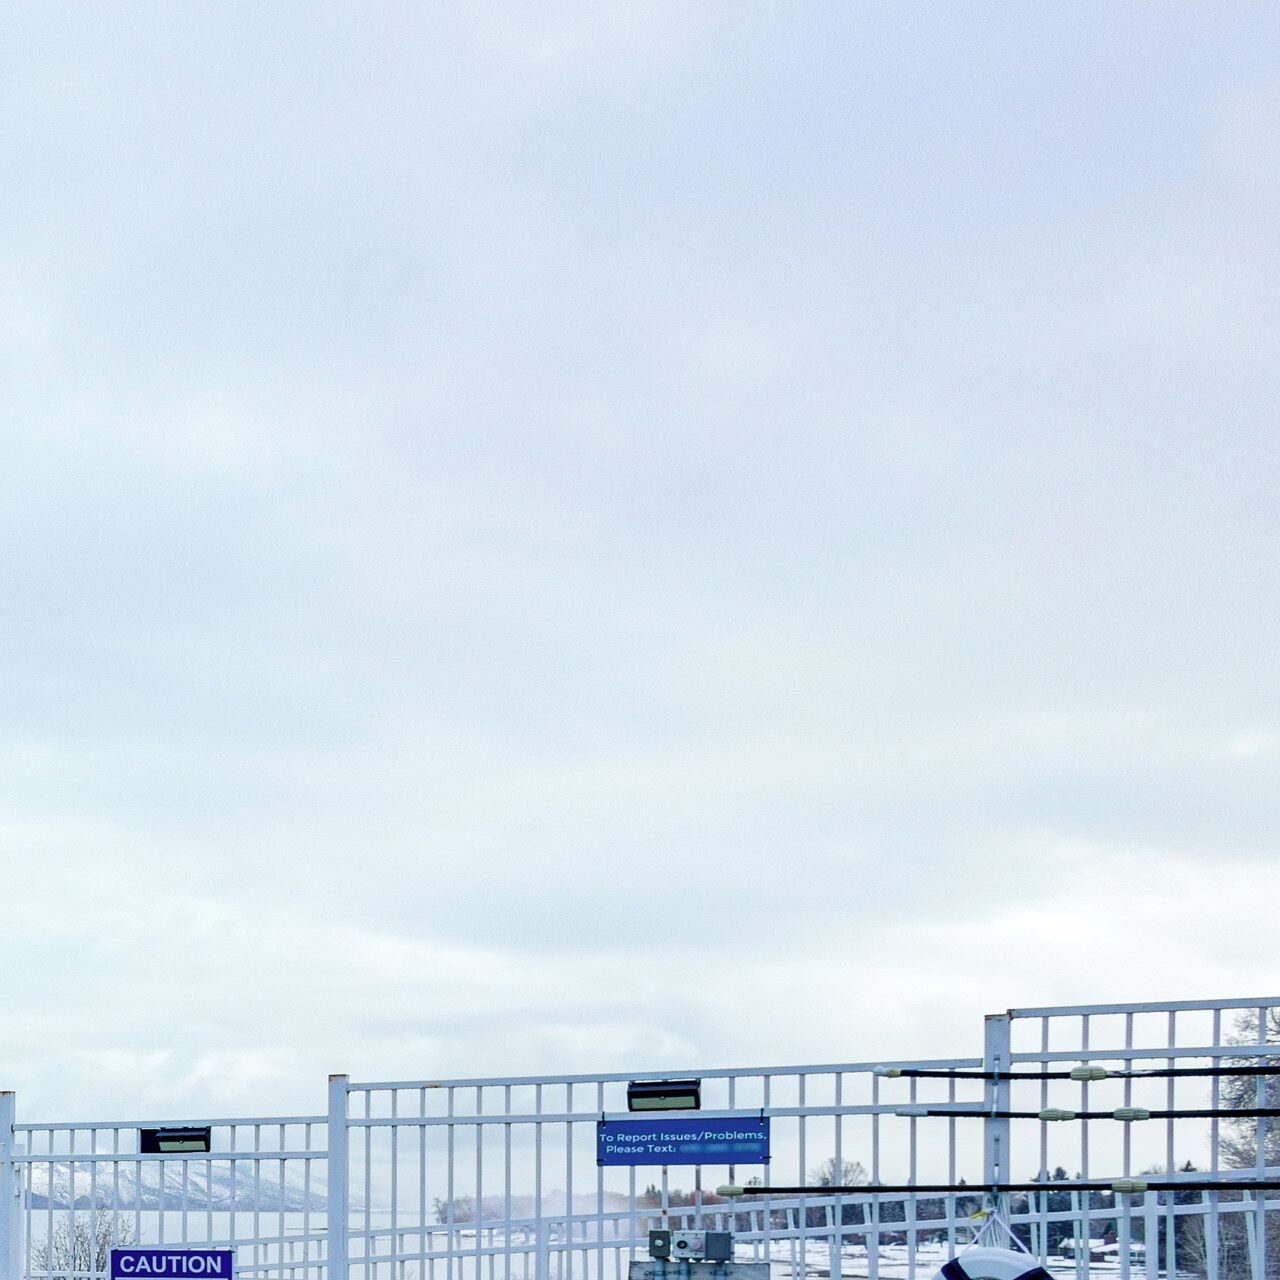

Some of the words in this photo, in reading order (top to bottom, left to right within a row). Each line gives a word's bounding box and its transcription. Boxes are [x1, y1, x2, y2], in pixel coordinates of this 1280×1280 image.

[600, 1134, 613, 1142] To
[617, 1133, 657, 1144] Report
[660, 1131, 767, 1141] Issues/Problems.
[607, 1145, 644, 1153] Please
[648, 1144, 676, 1152] Text:
[120, 1255, 221, 1273] CAUTION
